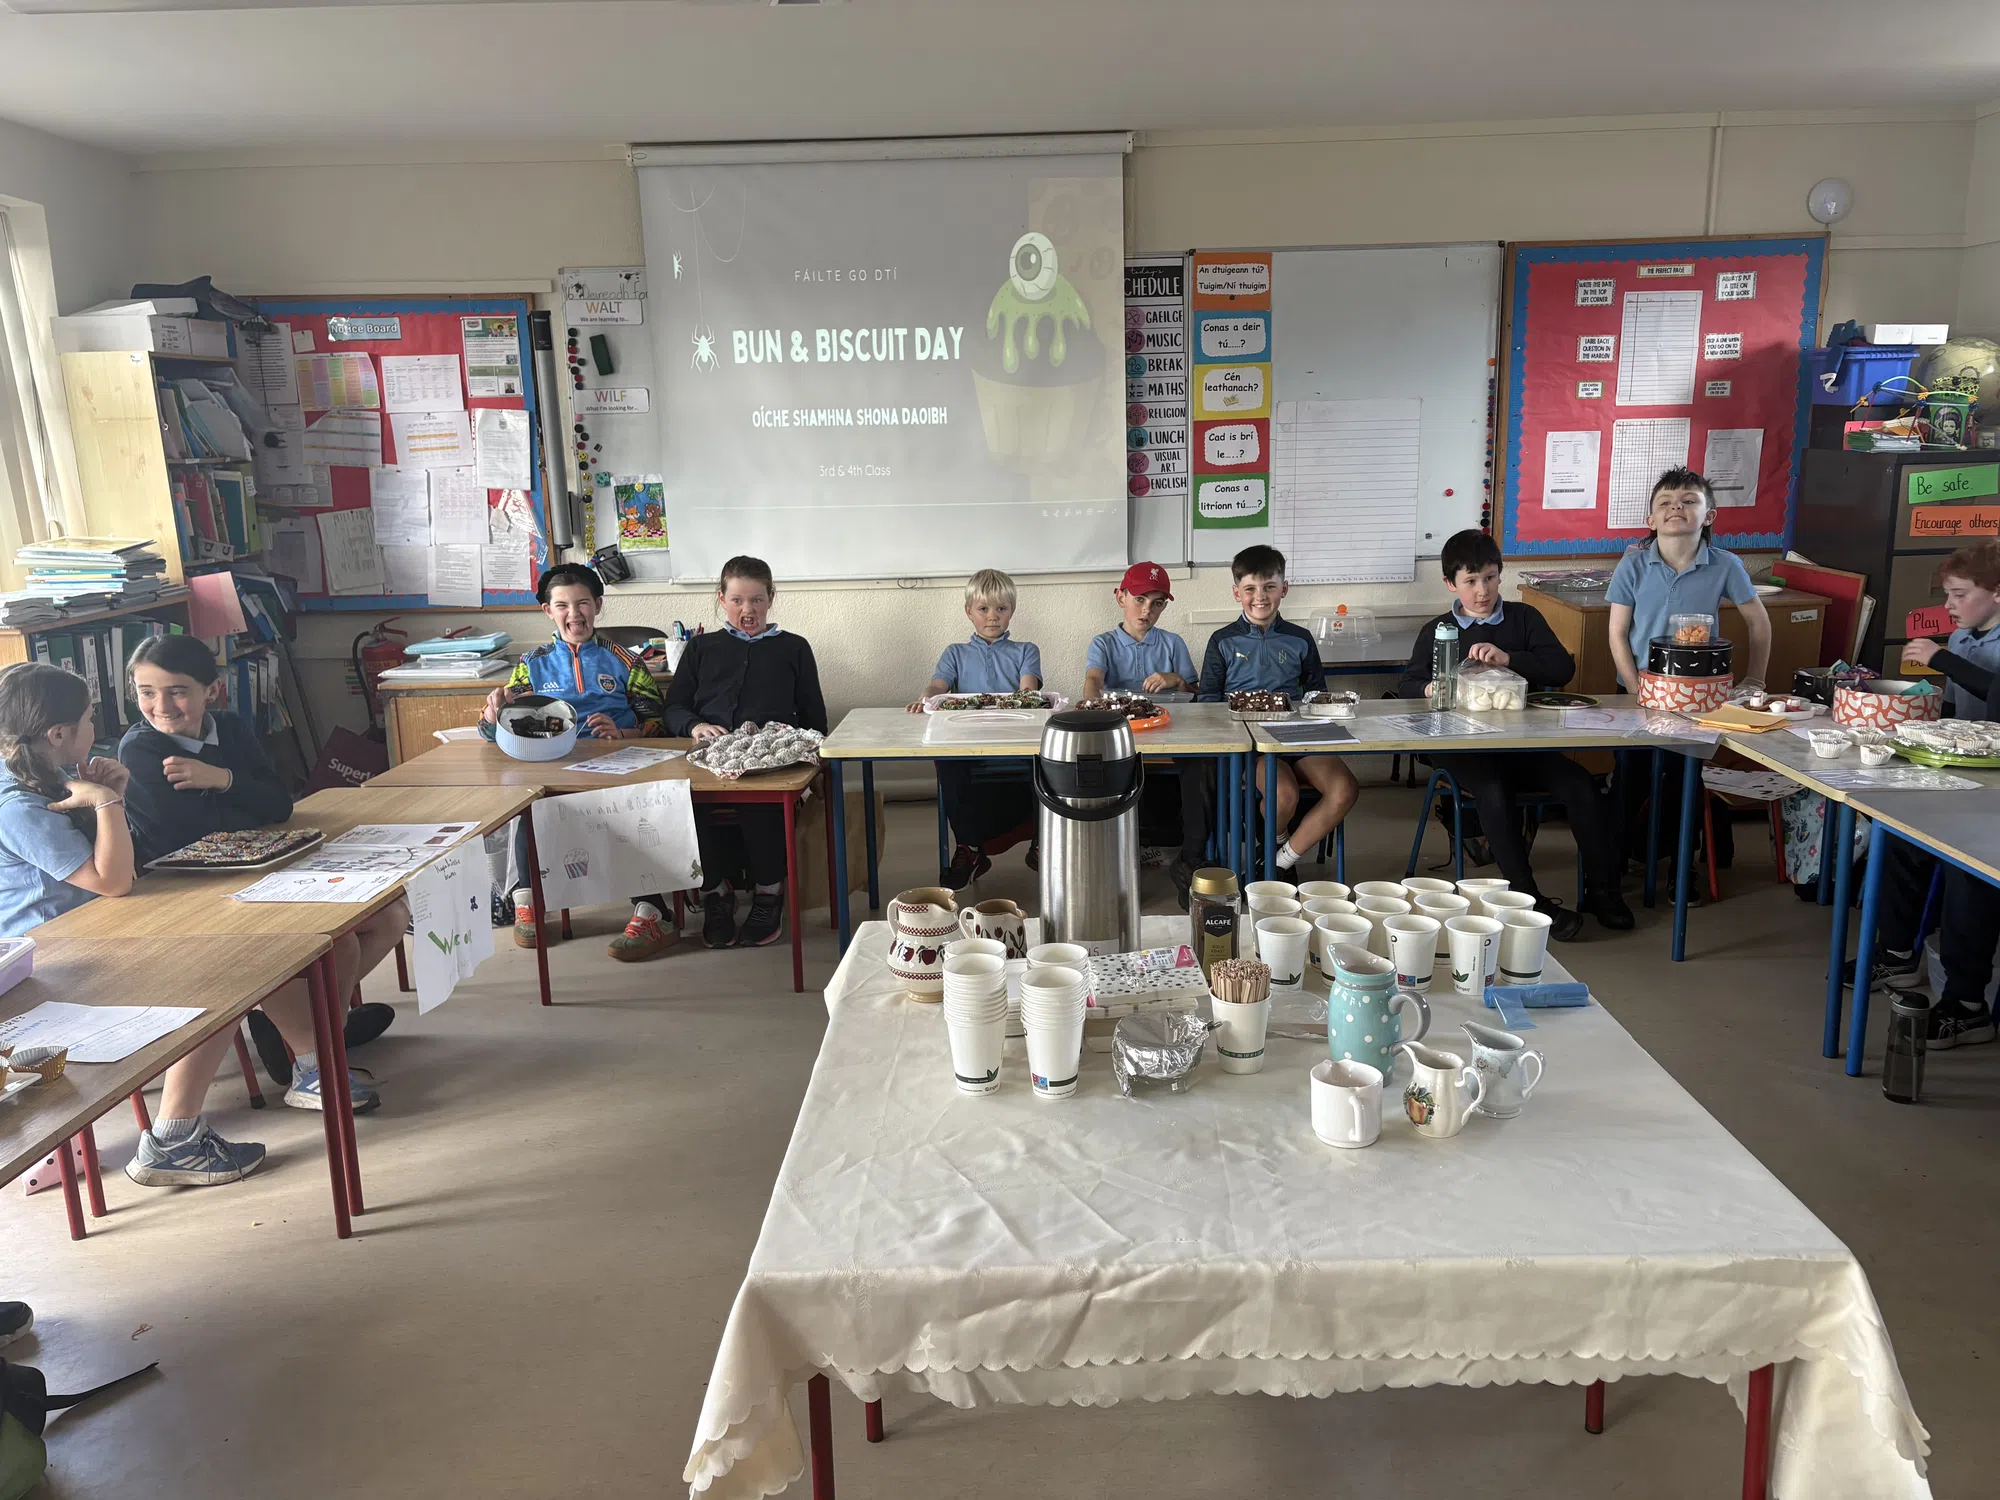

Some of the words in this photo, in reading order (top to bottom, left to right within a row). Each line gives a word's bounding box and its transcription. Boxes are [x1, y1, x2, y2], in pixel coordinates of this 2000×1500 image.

[794, 268, 841, 281] FÁILTE
[848, 269, 867, 281] GO
[874, 266, 897, 281] DTÍ
[1212, 266, 1248, 275] dtuigeann
[1252, 265, 1264, 274] tú?
[1124, 277, 1181, 296] CHEDULE
[1198, 281, 1237, 291] Tuigim/Ní
[1239, 281, 1267, 291] thuigim
[586, 302, 622, 313] WALT
[1145, 310, 1183, 323] GAEILGE
[331, 323, 364, 333] Notice
[366, 324, 398, 333] Board
[1203, 324, 1230, 332] Conas
[1242, 322, 1261, 331] deir
[732, 329, 783, 364] BUN
[790, 330, 809, 364] &
[815, 328, 908, 362] BISCUIT
[914, 326, 964, 361] DAY
[1146, 333, 1182, 348] MUSIC
[1148, 358, 1183, 372] BREAK
[1224, 372, 1241, 381] Cén
[1148, 382, 1184, 396] MATHS
[1204, 382, 1259, 392] leathanach?
[595, 390, 627, 402] WILF
[752, 405, 790, 427] OÍCHE
[793, 408, 853, 427] SHAMHNA
[857, 408, 899, 426] SHONA
[902, 407, 947, 425] DAOIBH
[1148, 407, 1186, 419] RELIGION
[1149, 430, 1185, 444] LUNCH
[1208, 433, 1226, 441] Cad
[1229, 433, 1236, 441] is
[1240, 431, 1254, 440] brí
[1154, 451, 1182, 461] VISUAL
[819, 464, 835, 477] 3rd
[838, 464, 845, 477] &
[847, 464, 863, 477] 4th
[865, 464, 891, 476] Class
[1160, 462, 1176, 473] ART
[1150, 477, 1187, 489] ENGLISH
[1214, 484, 1240, 493] Conas
[1917, 476, 1933, 495] Be
[1200, 501, 1233, 511] litríonn
[1915, 512, 1962, 535] Encourage
[1913, 612, 1940, 634] Play
[542, 681, 560, 689] GAA
[1140, 849, 1162, 862] able
[1205, 918, 1231, 926] ALCAFÉ
